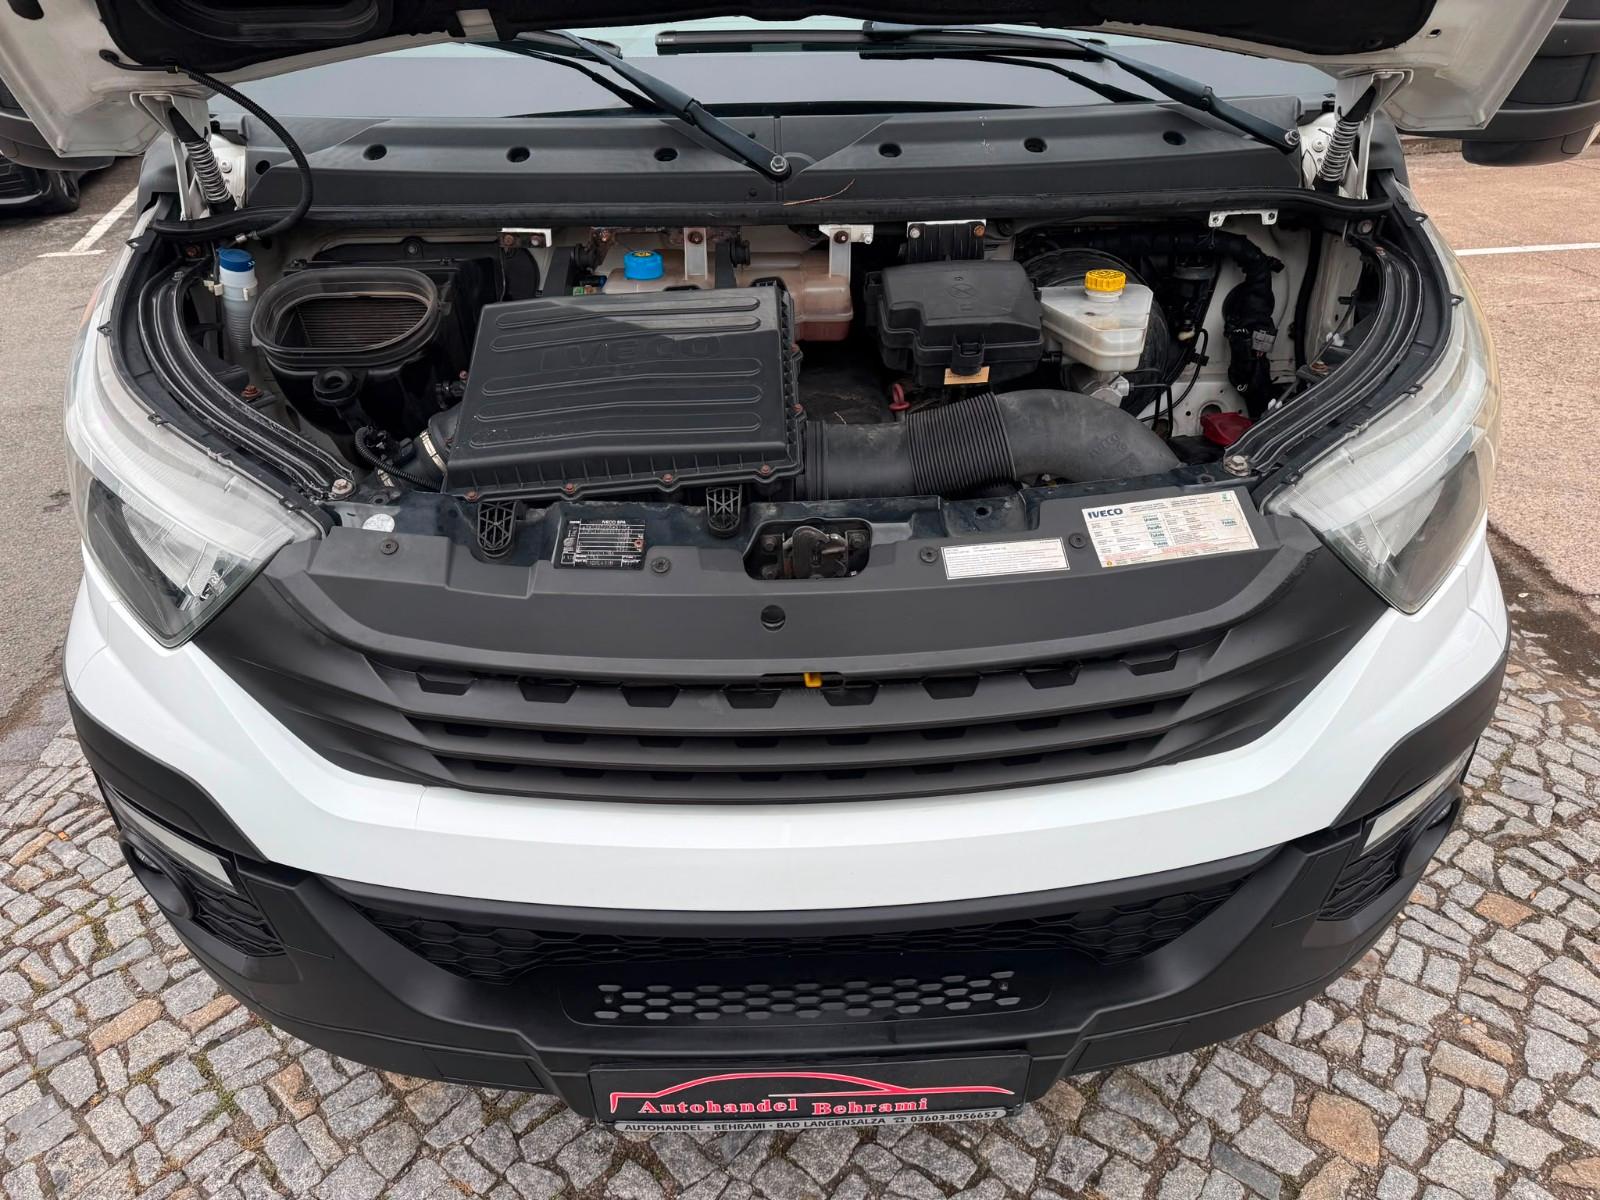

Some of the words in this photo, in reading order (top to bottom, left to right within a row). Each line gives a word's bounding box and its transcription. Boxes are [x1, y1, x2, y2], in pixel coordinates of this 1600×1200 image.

[1087, 508, 1123, 519] IVECO
[638, 1098, 798, 1114] Autohandel
[811, 1098, 928, 1116] Behrami
[624, 1123, 706, 1131] AUTOHANDEL
[713, 1122, 766, 1131] BEHRAMI
[776, 1121, 801, 1129] BAD
[803, 1117, 886, 1128] LANGENSALZA
[910, 1110, 998, 1123] 03603-8956652
